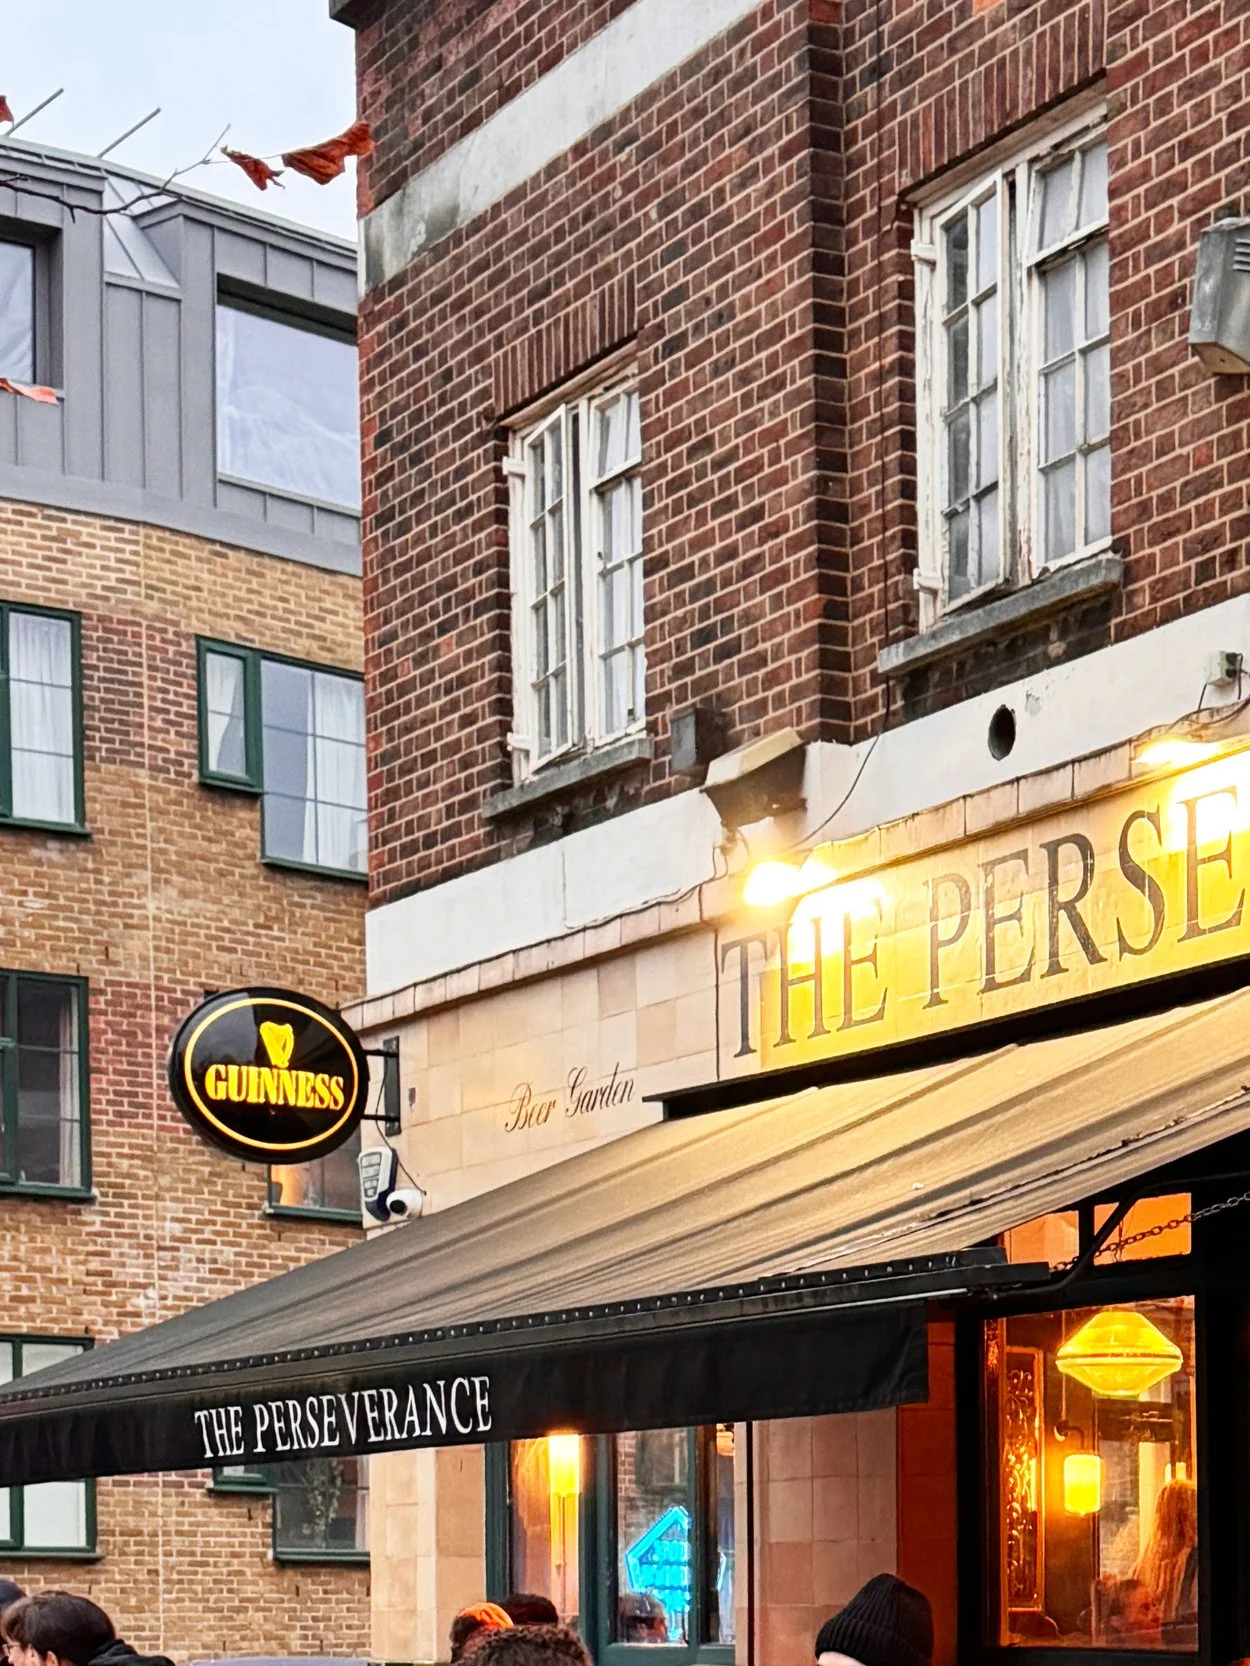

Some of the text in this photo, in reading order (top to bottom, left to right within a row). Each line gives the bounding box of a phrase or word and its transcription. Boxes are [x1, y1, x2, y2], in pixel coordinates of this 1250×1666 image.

[721, 896, 888, 1058] THE
[205, 1064, 345, 1110] GUINNESS
[504, 1061, 636, 1133] Beer Garden
[194, 1375, 492, 1459] THE PERSEVERANCE
